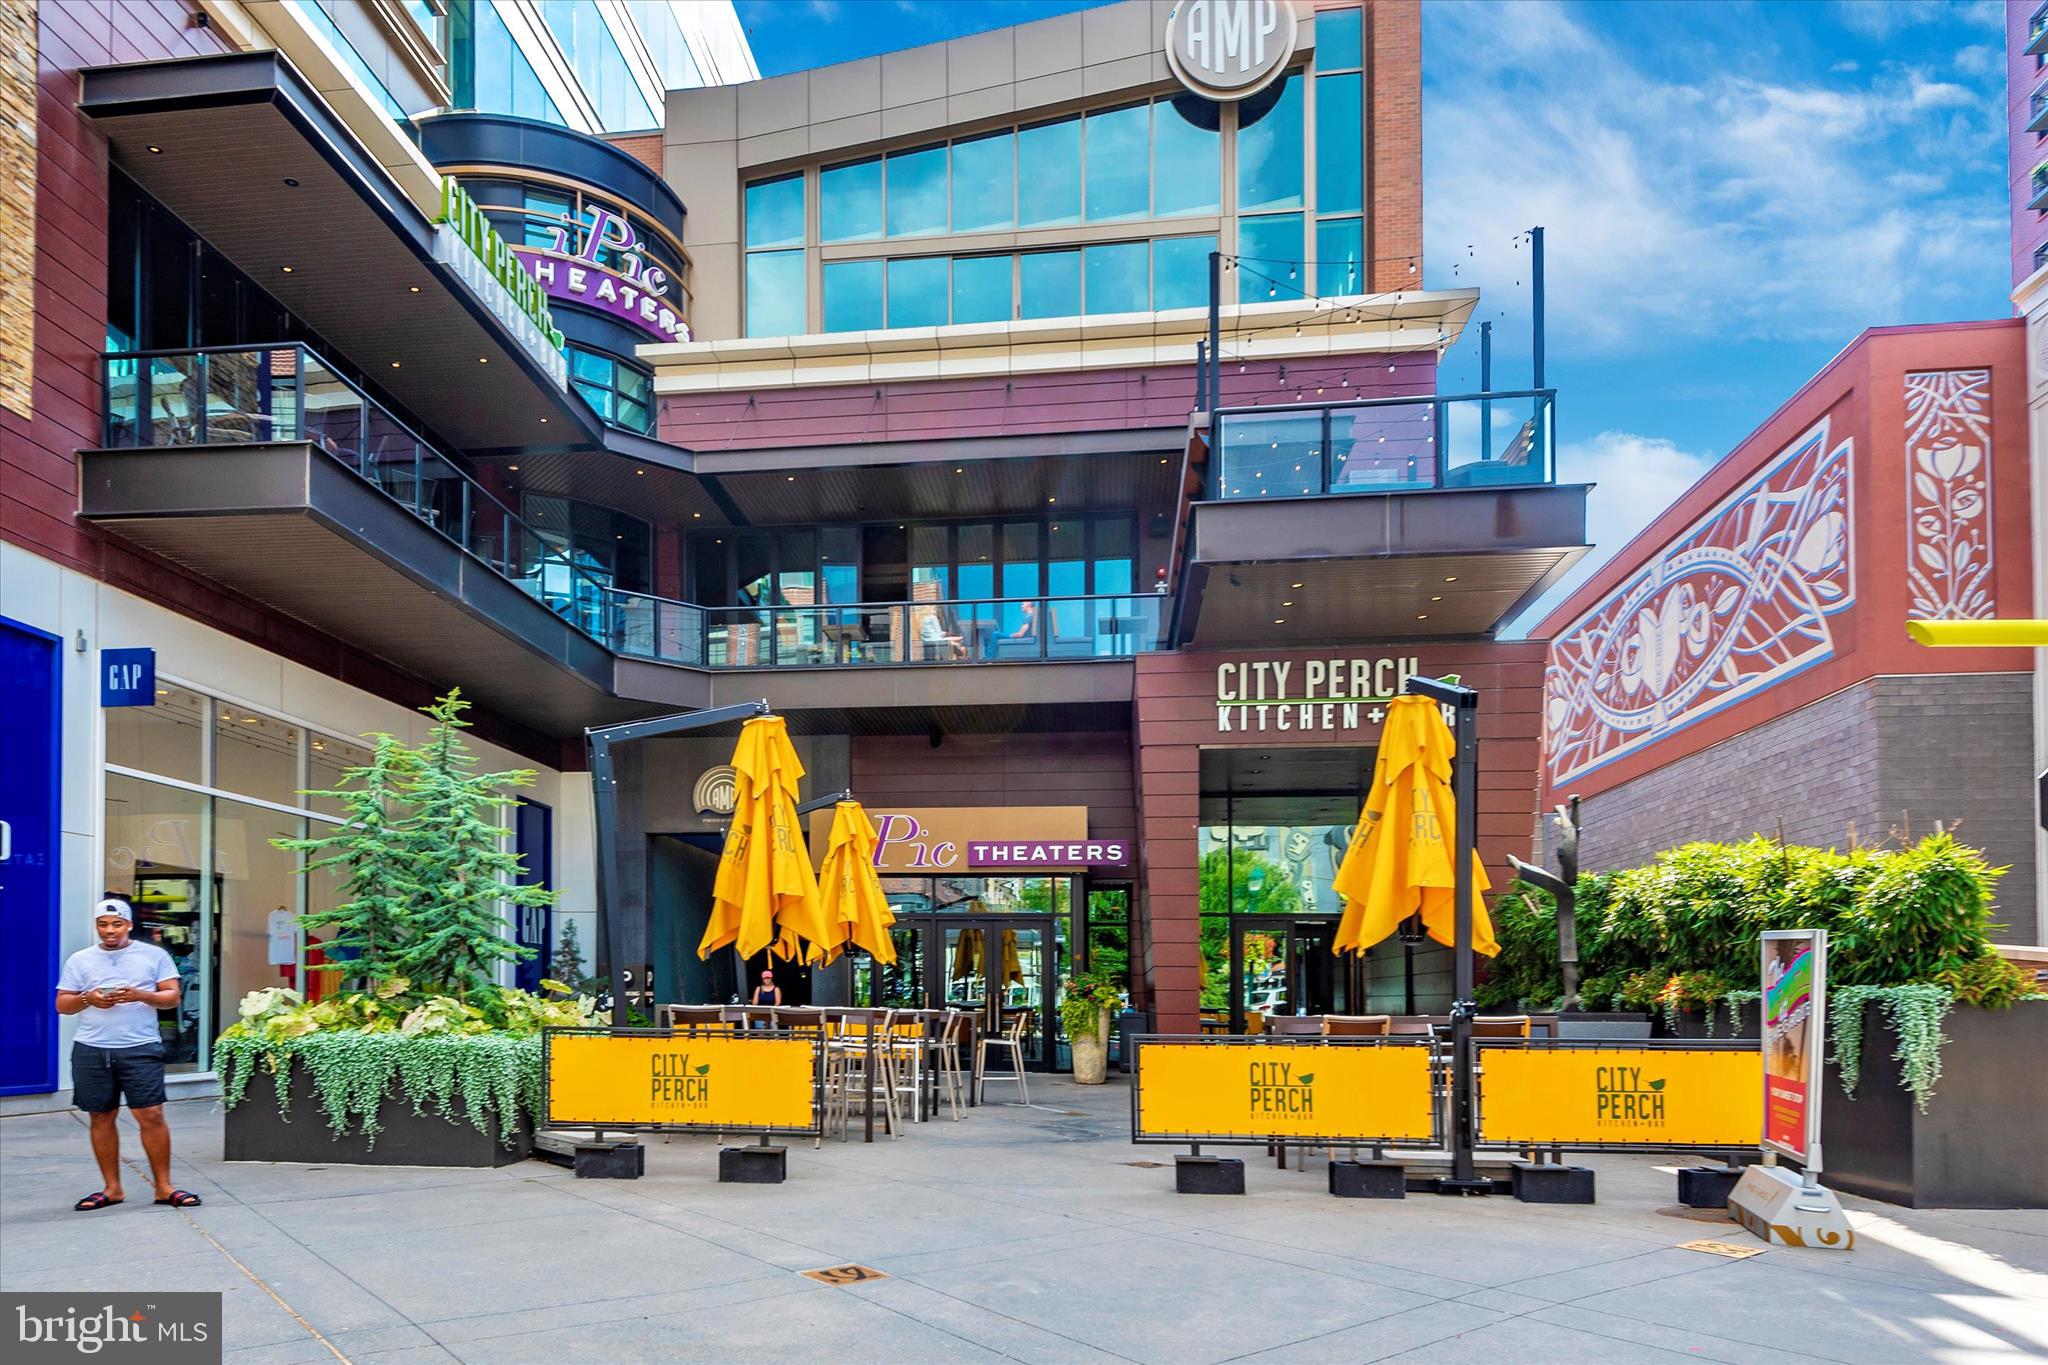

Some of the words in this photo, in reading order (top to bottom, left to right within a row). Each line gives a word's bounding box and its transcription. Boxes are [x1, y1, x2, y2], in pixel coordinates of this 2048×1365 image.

[1188, 0, 1277, 74] AMP
[442, 176, 492, 268] CITY
[489, 229, 549, 335] PERCH
[535, 260, 690, 342] HEATERS
[109, 664, 142, 691] GAP
[1217, 662, 1292, 701] CITY
[1306, 657, 1418, 699] PERCH
[872, 814, 958, 868] Pic
[973, 844, 1123, 862] THEATERS
[522, 906, 546, 945] GAP
[652, 1054, 689, 1076] CITY
[1250, 1062, 1291, 1086] CITY
[652, 1079, 708, 1101] PERCH
[1597, 1067, 1641, 1091] CITY
[1250, 1088, 1313, 1112] PERCH
[1597, 1094, 1664, 1119] PERCH
